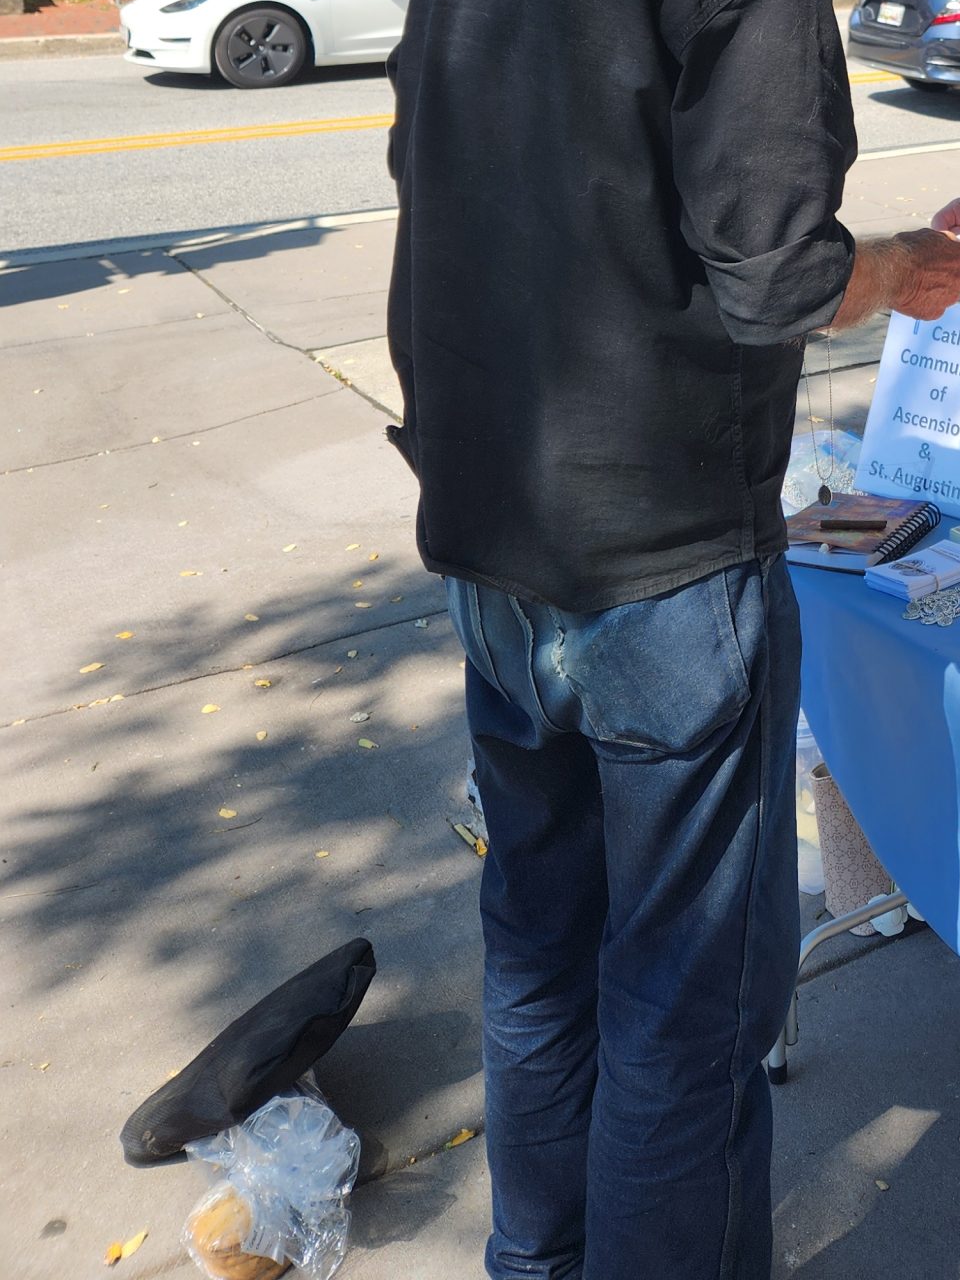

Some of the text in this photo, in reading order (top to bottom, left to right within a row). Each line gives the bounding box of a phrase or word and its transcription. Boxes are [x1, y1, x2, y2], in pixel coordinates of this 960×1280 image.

[929, 386, 948, 402] of
[918, 442, 931, 461] &
[868, 460, 888, 480] St.
